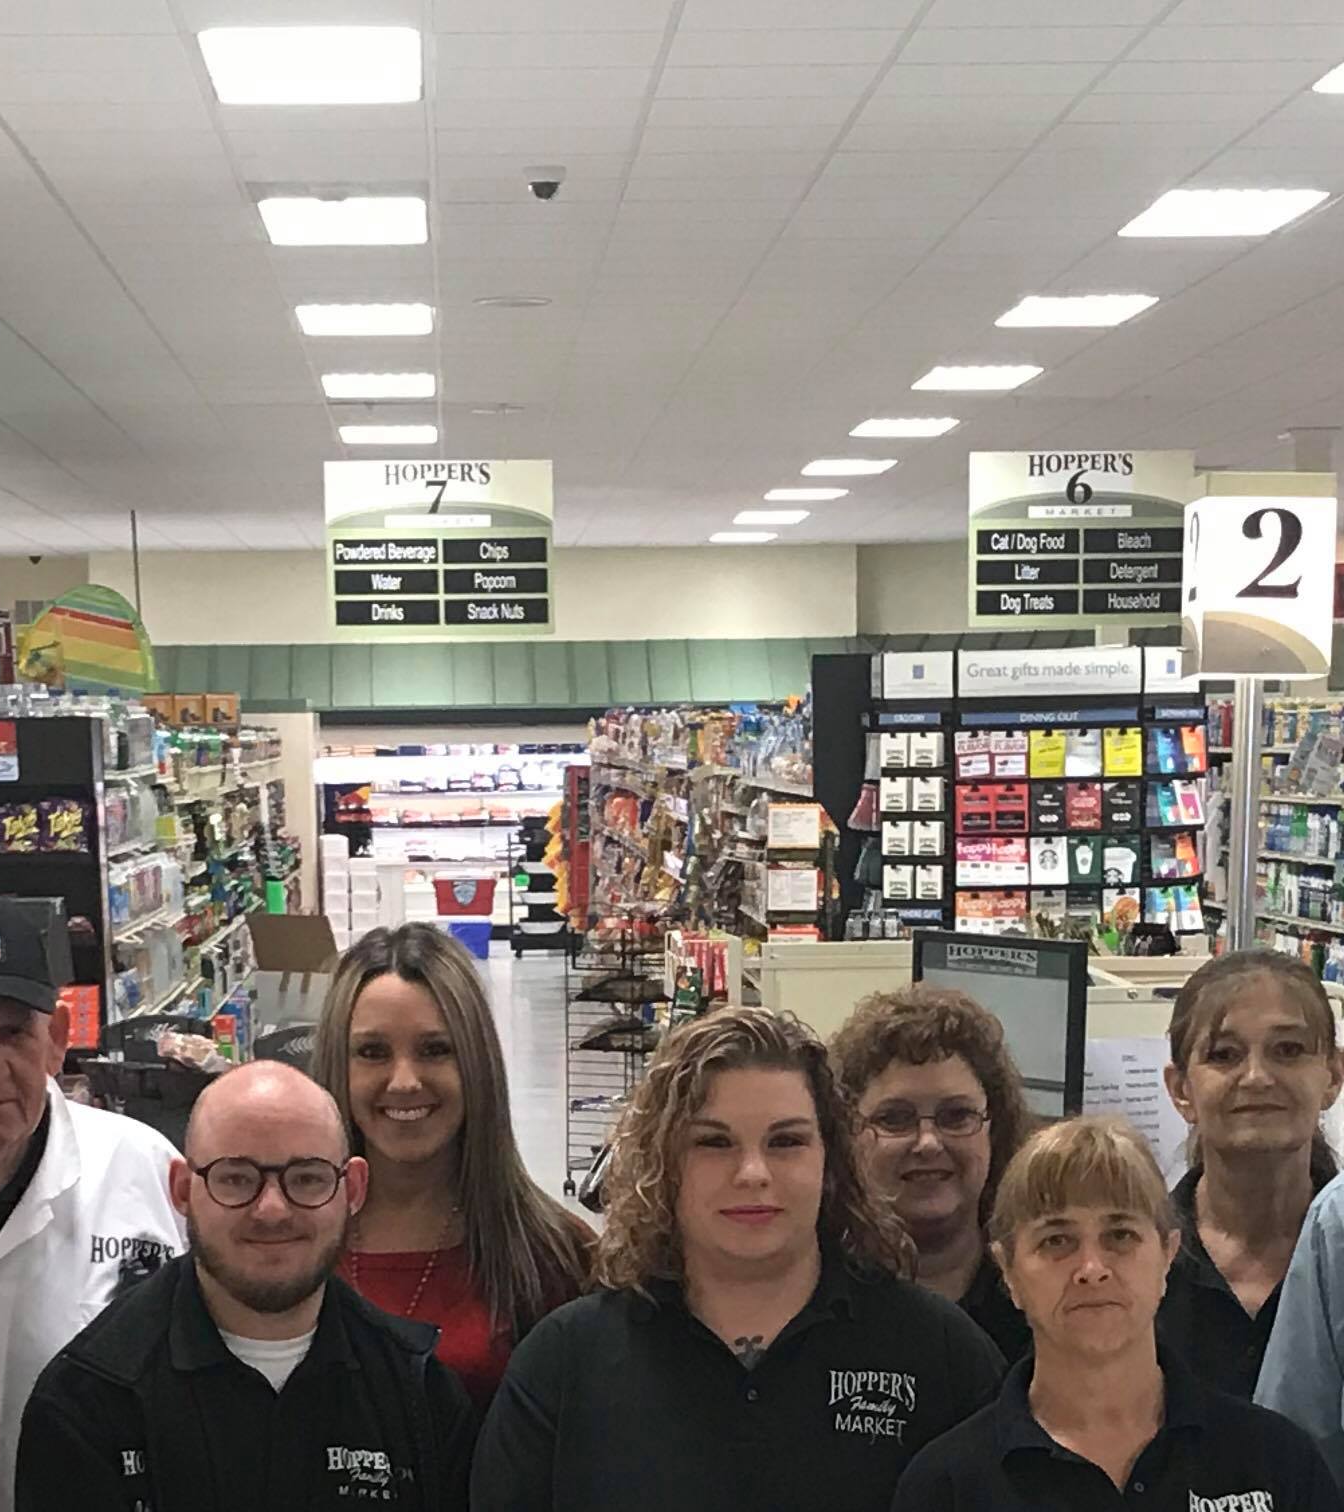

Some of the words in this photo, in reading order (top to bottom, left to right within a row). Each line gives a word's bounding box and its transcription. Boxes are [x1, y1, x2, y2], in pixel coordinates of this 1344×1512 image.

[384, 462, 491, 486] HOPPER'S
[1028, 453, 1133, 476] HOPPER'S
[1066, 469, 1093, 504] 6
[425, 480, 449, 514] 7
[1045, 508, 1117, 516] MARKET
[991, 533, 1009, 550] Cat
[1017, 534, 1038, 553] Dog
[1040, 533, 1065, 550] Food
[1117, 532, 1152, 550] Bleach
[336, 543, 386, 560] Powdered
[388, 543, 436, 563] Beverage
[479, 542, 509, 563] Chips
[1234, 507, 1303, 599] 2
[371, 574, 403, 590] Water
[1014, 564, 1041, 581] Litter
[1110, 562, 1159, 584] Detergent
[1000, 594, 1022, 614] Dog
[1022, 593, 1055, 611] Treats
[1108, 591, 1161, 610] Household
[371, 603, 405, 621] Drinks
[467, 603, 500, 620] Snack
[501, 603, 525, 620] Nuts
[967, 663, 1008, 677] Great
[1011, 662, 1039, 681] gifts
[1042, 661, 1082, 677] made
[1019, 712, 1055, 723] DINING
[1057, 711, 1080, 722] OUT
[828, 1370, 916, 1412] HOPPER'S
[835, 1413, 908, 1437] MARKET
